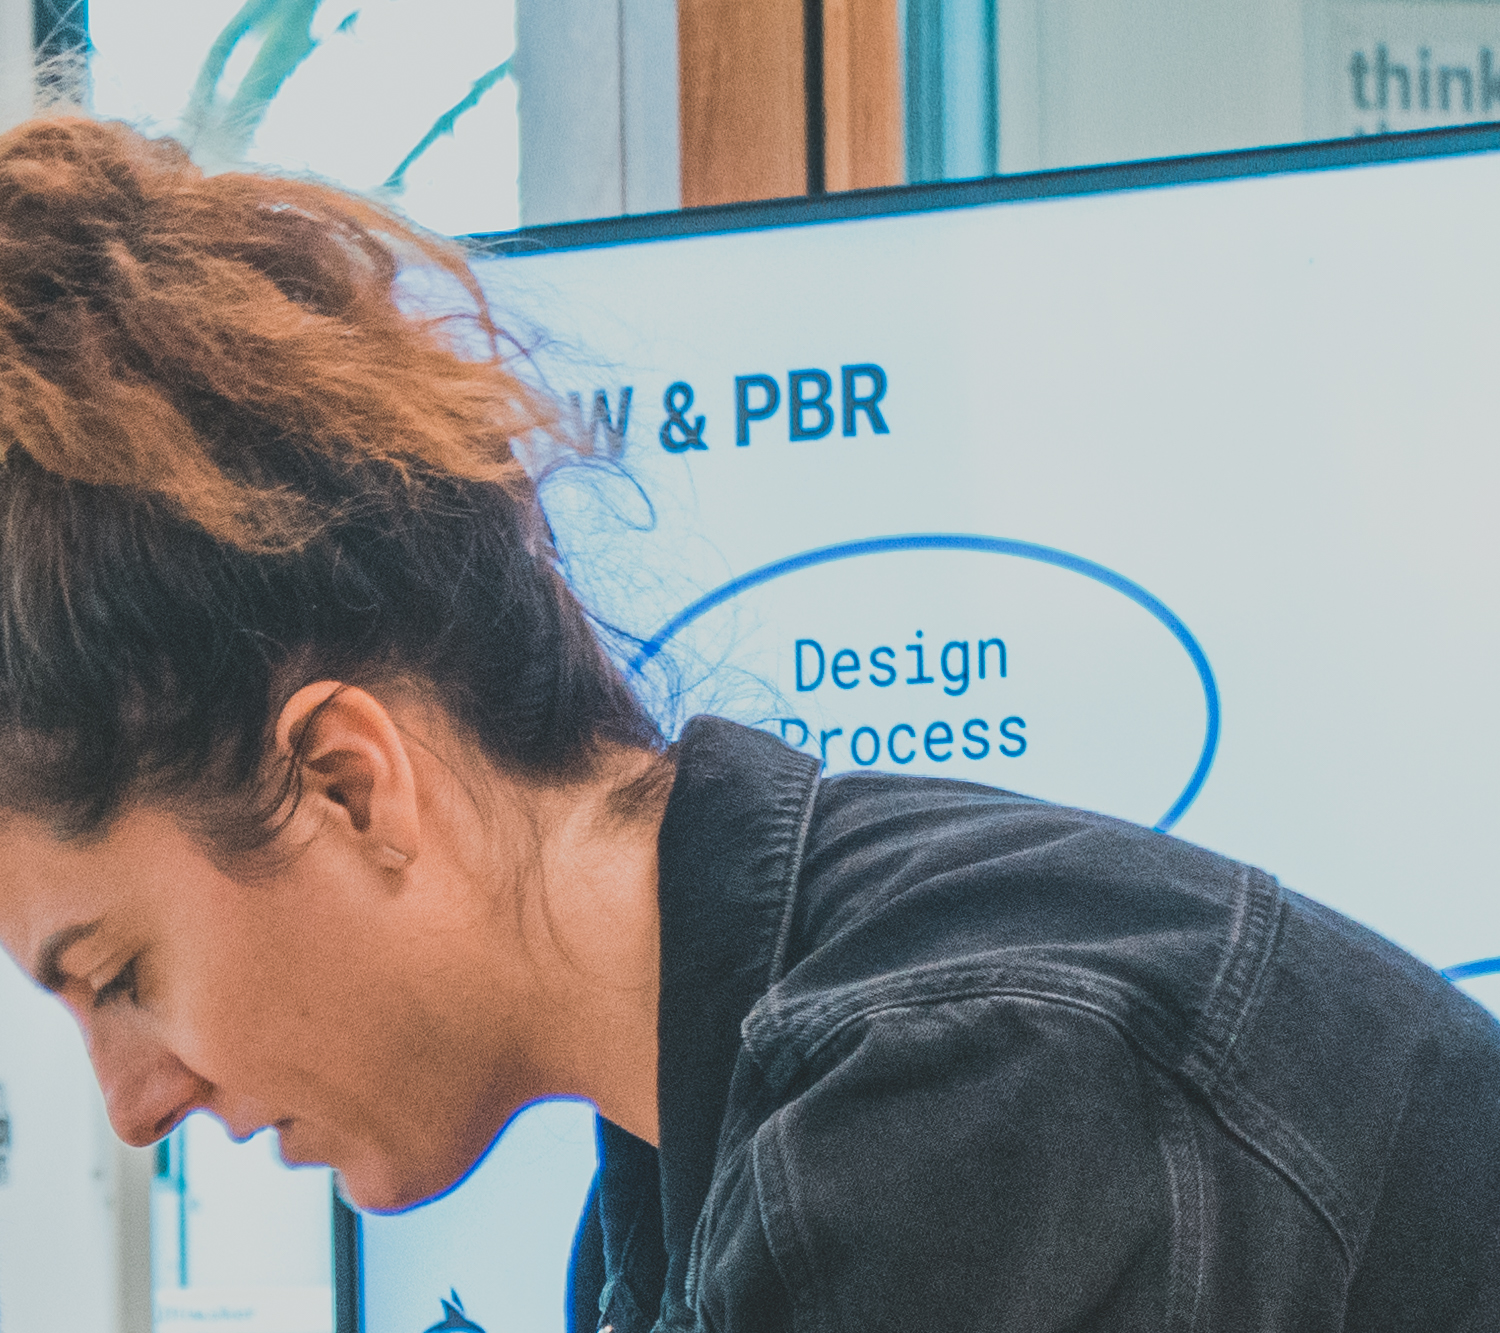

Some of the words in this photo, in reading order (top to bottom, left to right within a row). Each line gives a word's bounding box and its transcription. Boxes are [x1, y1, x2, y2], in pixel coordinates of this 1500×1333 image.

[660, 381, 710, 454] &
[734, 362, 891, 448] PBR
[794, 629, 1007, 697] Design
[780, 715, 1028, 773] Process
